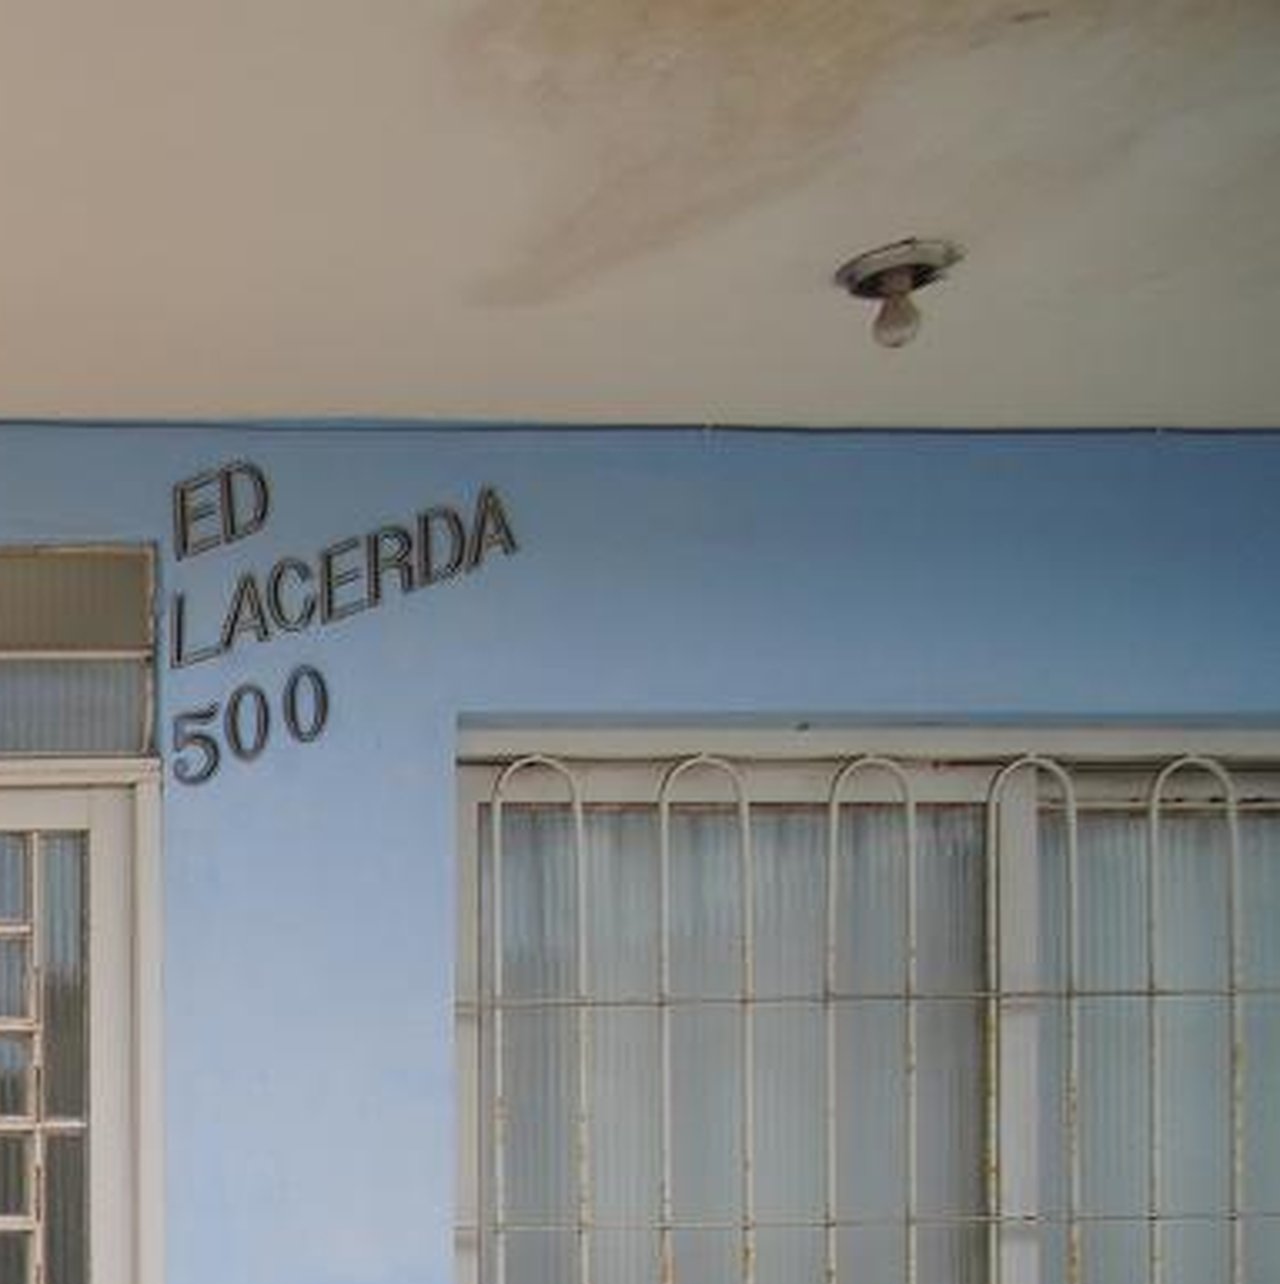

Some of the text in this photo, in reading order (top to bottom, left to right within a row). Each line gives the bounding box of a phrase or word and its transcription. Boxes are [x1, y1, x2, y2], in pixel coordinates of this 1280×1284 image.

[173, 460, 270, 562] ED
[171, 483, 520, 669] LACERDA
[172, 664, 329, 785] 500
